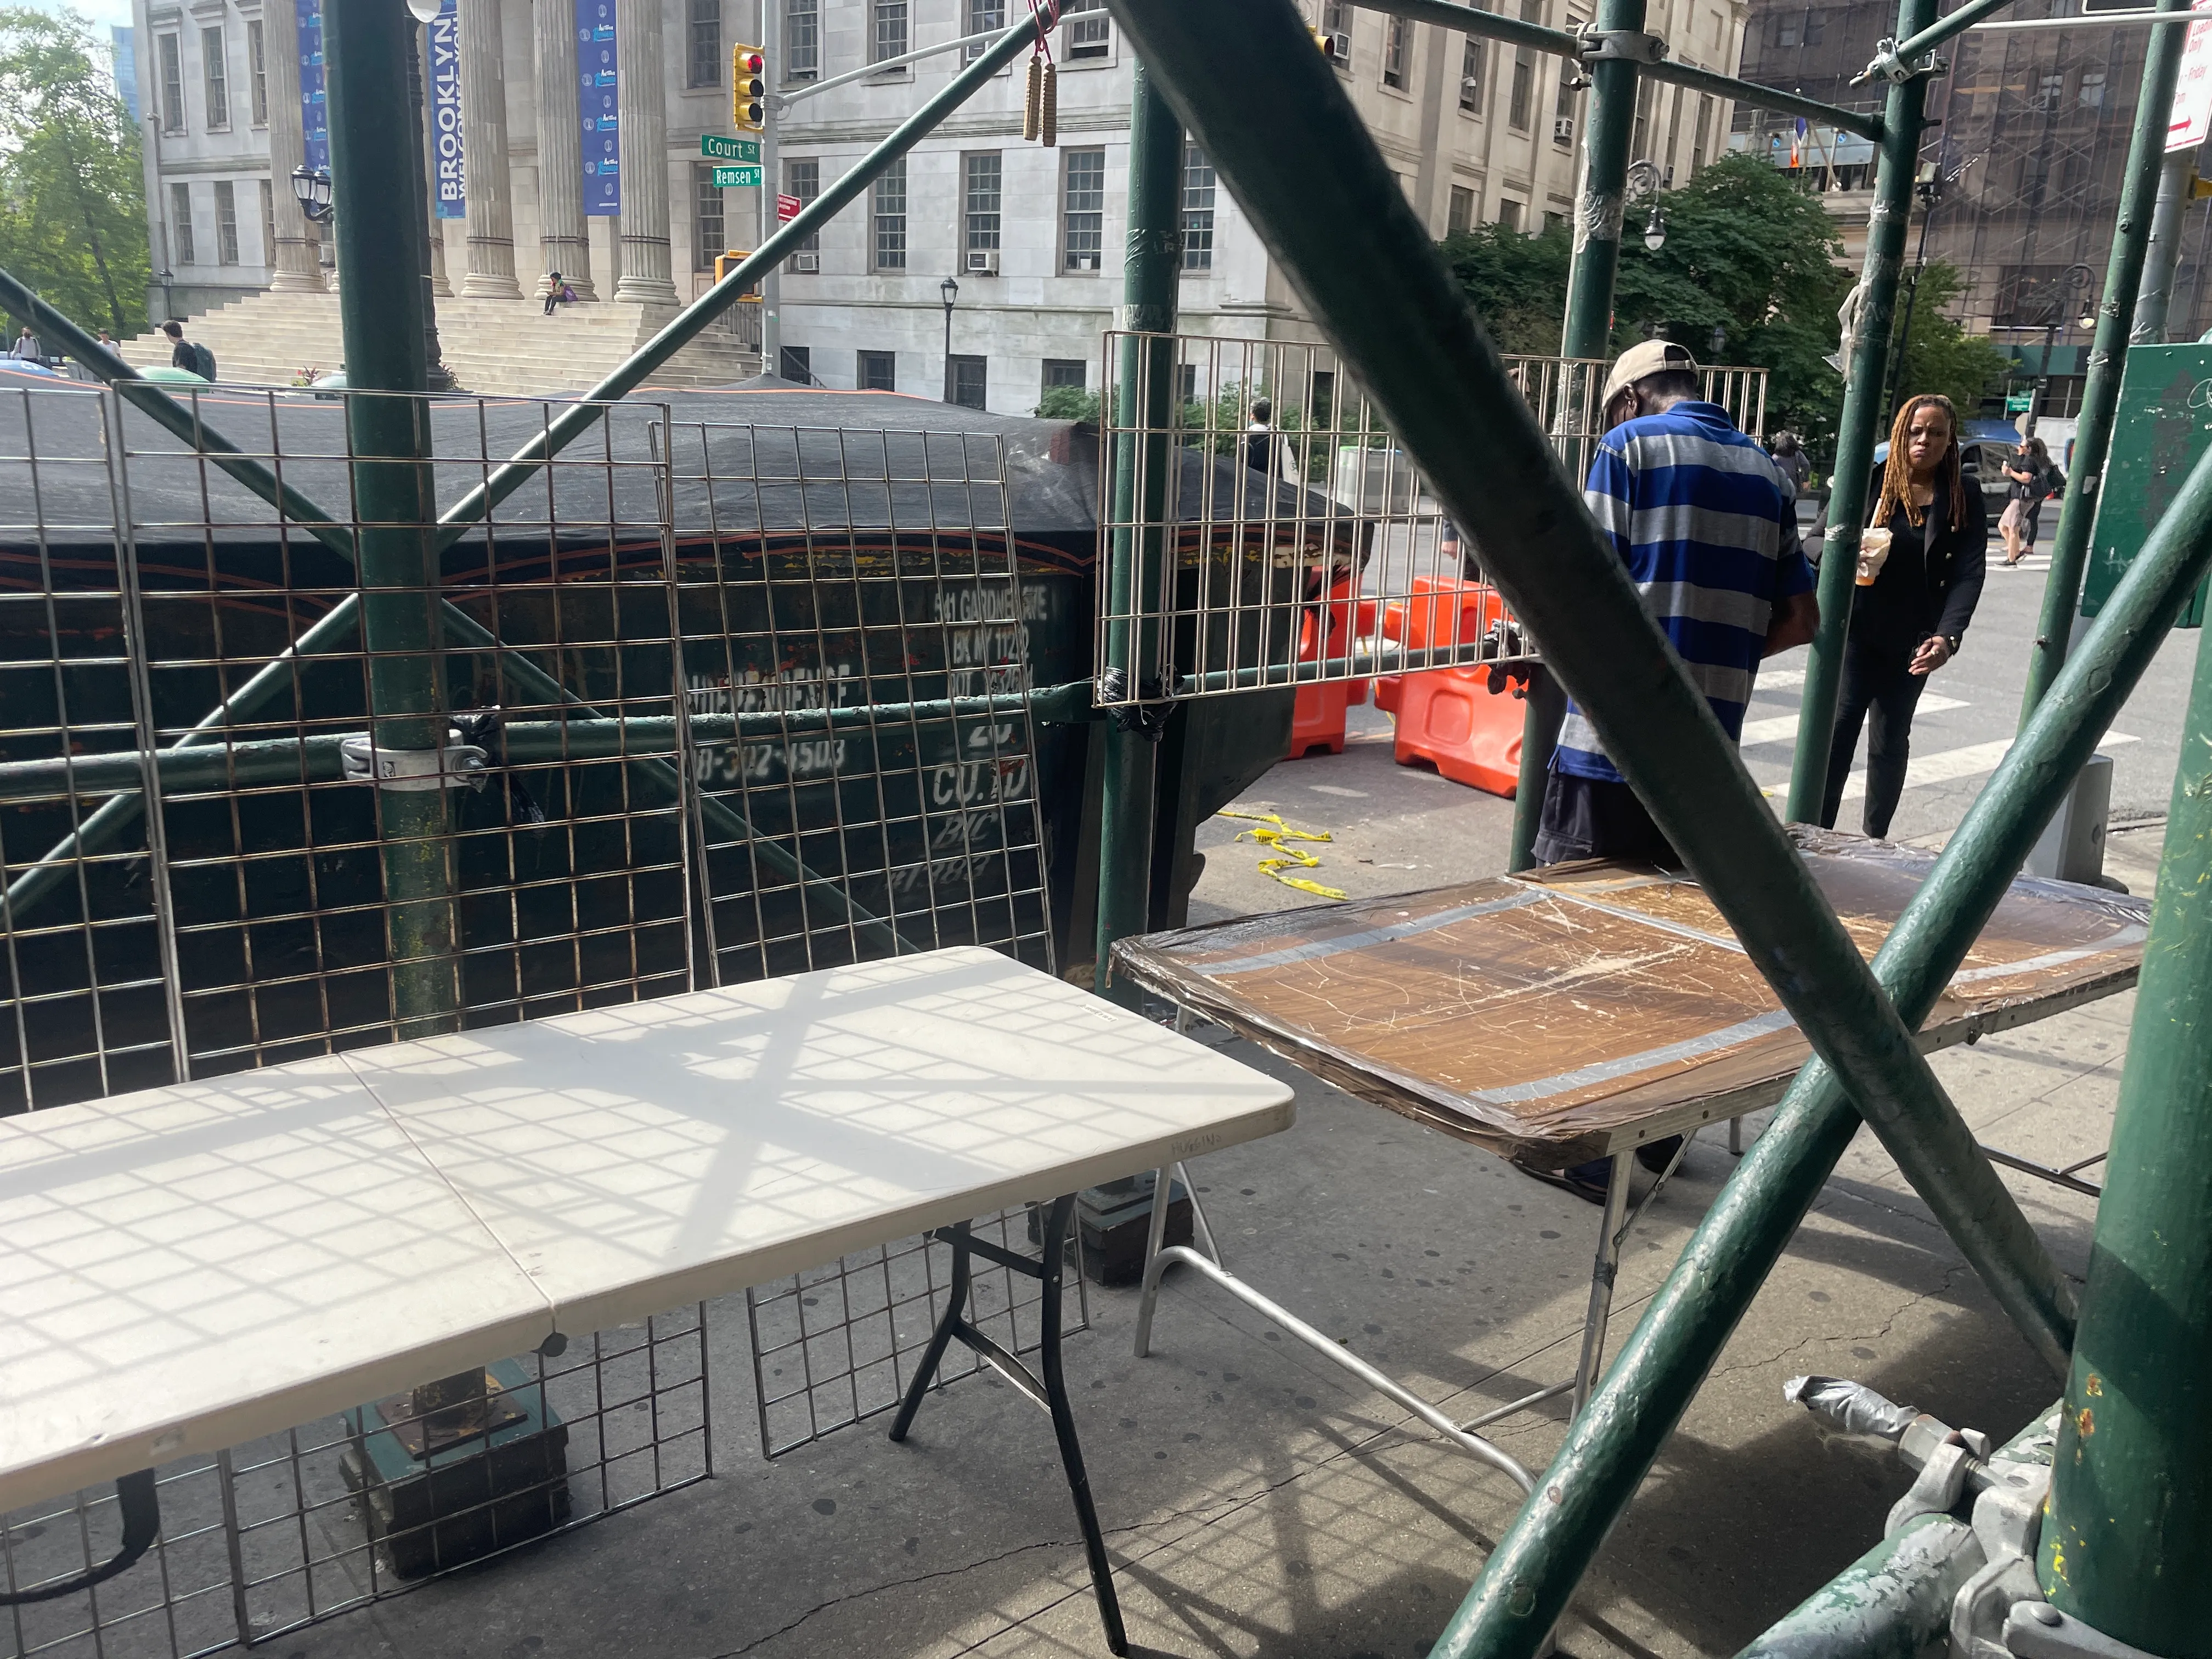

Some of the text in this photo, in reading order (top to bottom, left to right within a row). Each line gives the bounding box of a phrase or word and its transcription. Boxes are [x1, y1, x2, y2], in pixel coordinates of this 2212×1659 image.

[2188, 63, 2208, 82] Friday
[433, 18, 458, 200] BROOKLYN
[708, 138, 755, 158] Court St
[716, 168, 760, 184] Remsen St
[934, 760, 984, 805] CU.
